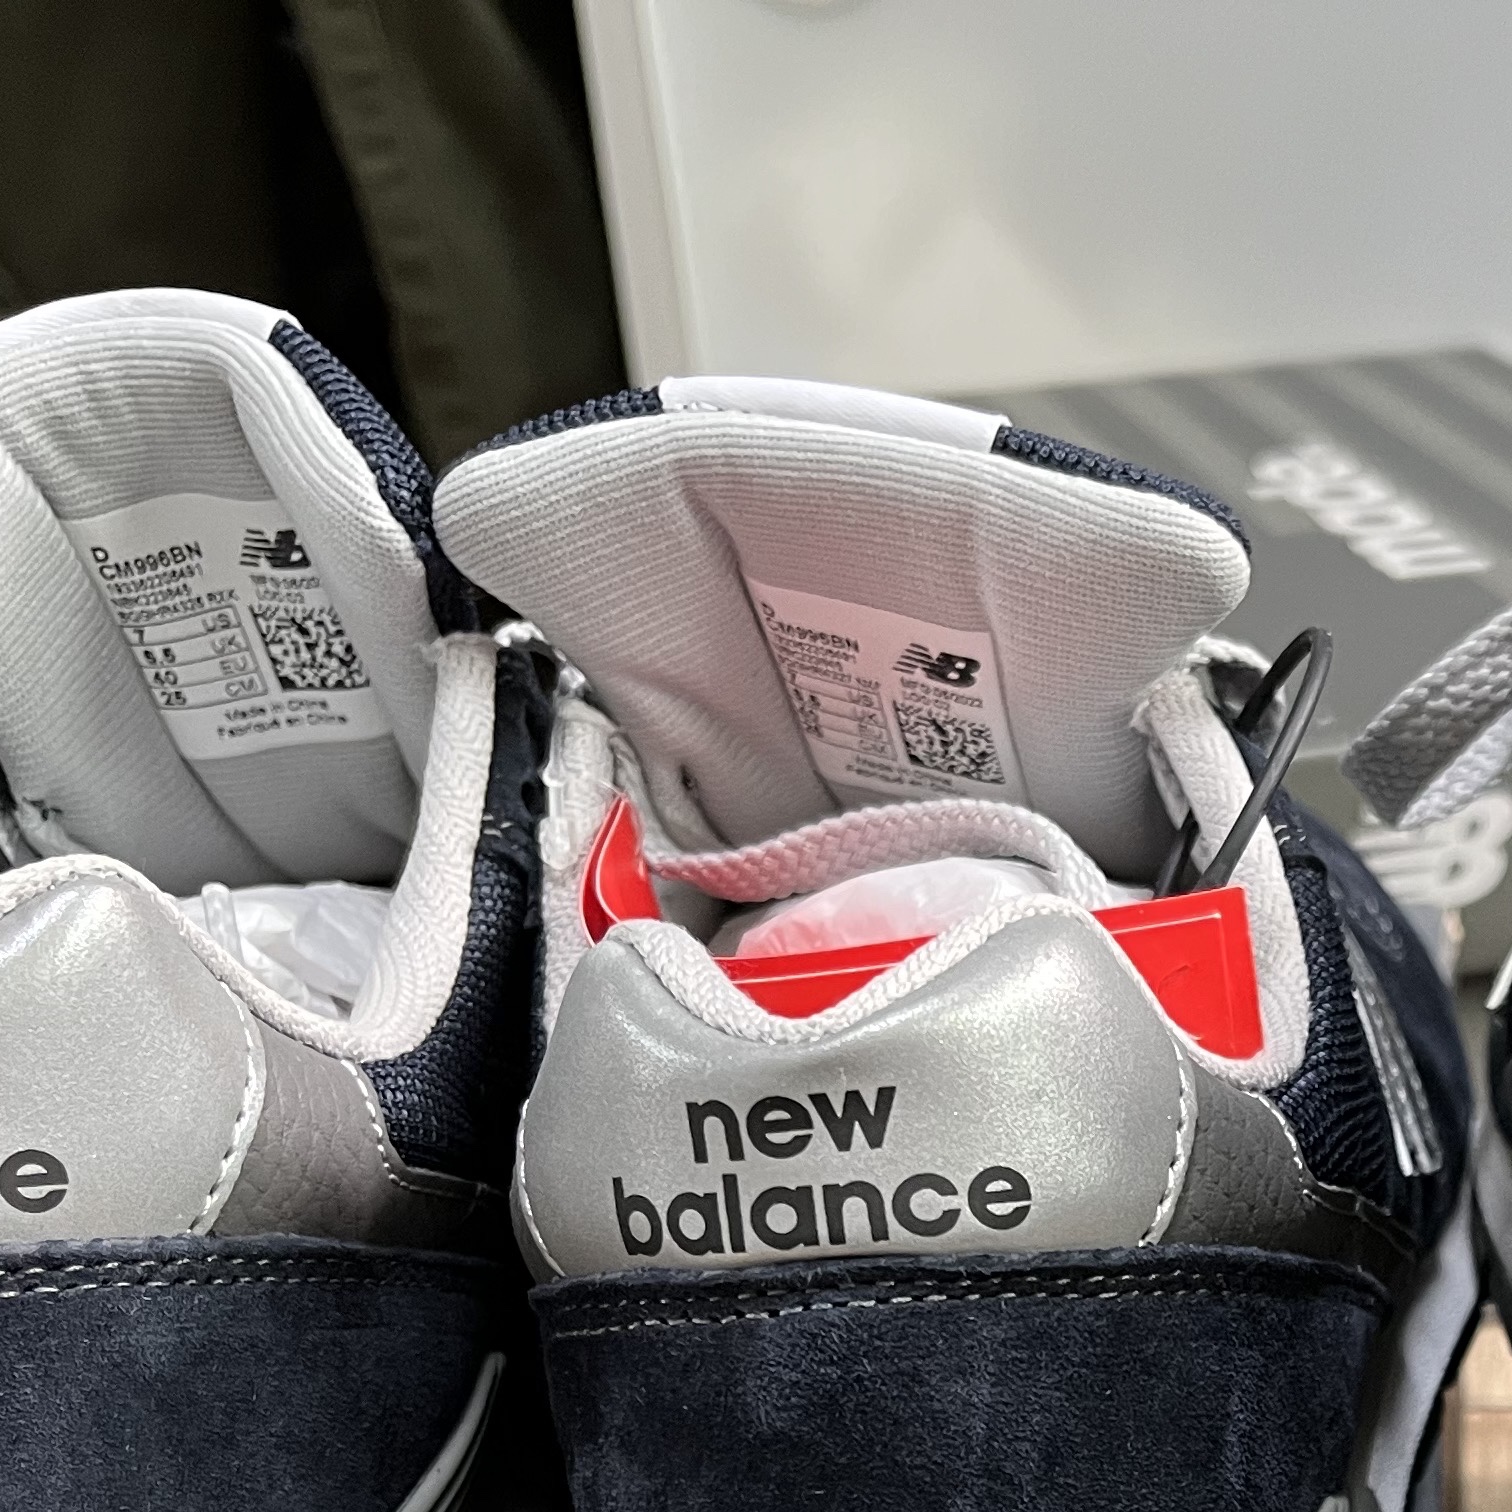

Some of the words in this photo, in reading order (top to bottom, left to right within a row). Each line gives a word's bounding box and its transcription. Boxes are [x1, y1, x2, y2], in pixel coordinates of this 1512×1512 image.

[91, 546, 109, 563] D
[99, 541, 203, 580] CM996BN
[201, 613, 232, 632] US
[160, 690, 187, 706] 25
[686, 1086, 896, 1163] new
[612, 1165, 1032, 1257] balance
